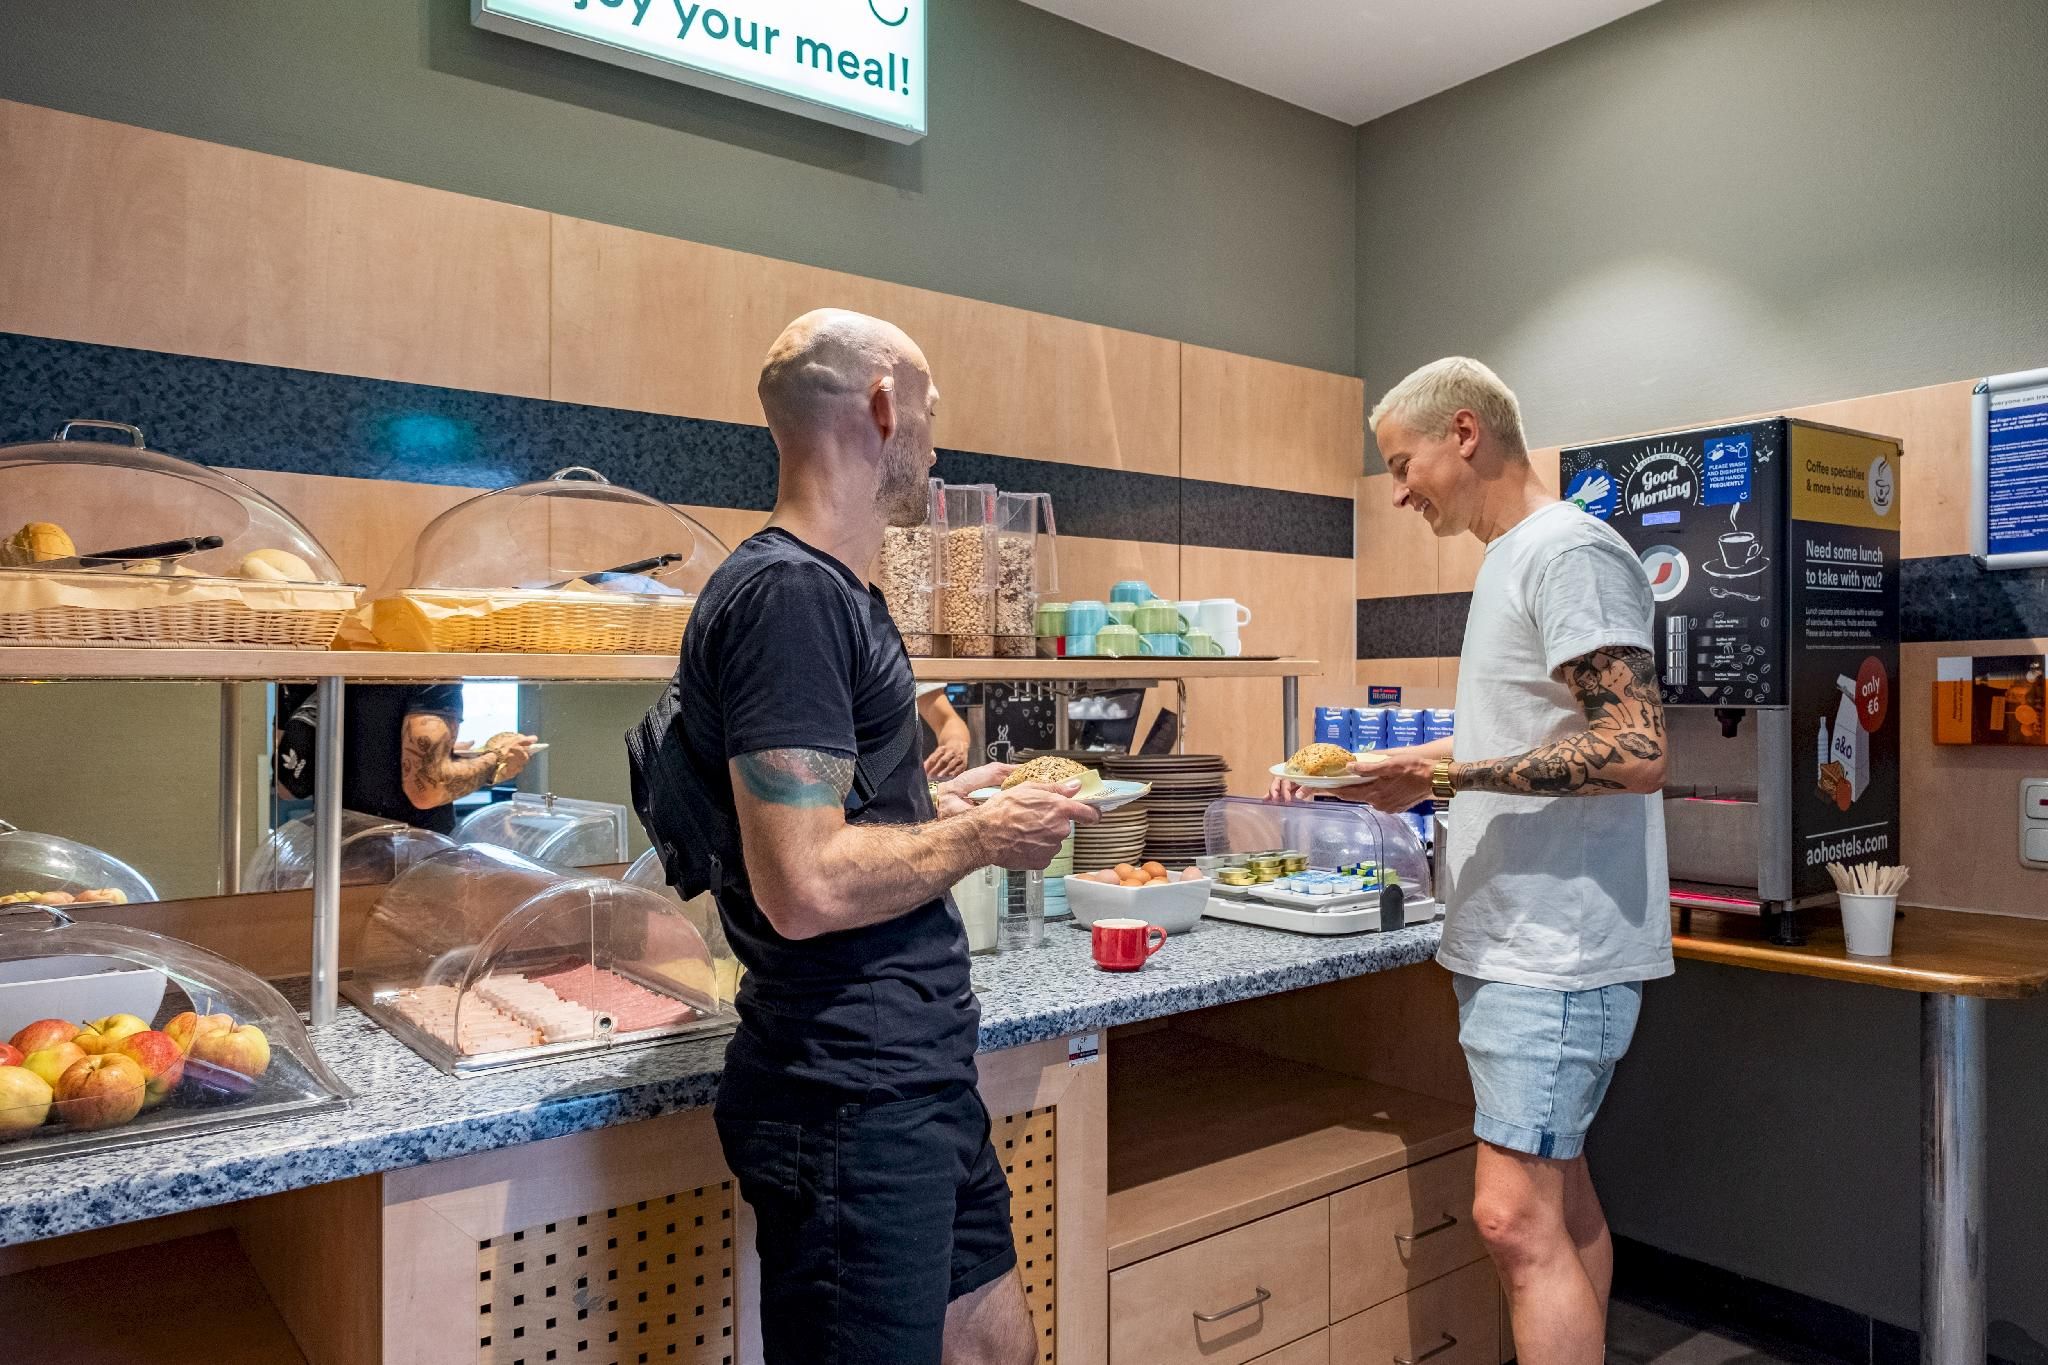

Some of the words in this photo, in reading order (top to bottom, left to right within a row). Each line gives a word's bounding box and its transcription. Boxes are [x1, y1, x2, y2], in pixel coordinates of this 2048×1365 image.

[674, 0, 780, 55] your
[796, 34, 909, 96] meal!
[1641, 465, 1678, 491] Good
[1806, 459, 1829, 475] Coffee
[1830, 463, 1865, 481] specialties
[1709, 480, 1744, 488] FREQUENTLY
[1806, 479, 1812, 491] &
[1813, 483, 1831, 494] more
[1832, 483, 1843, 496] hot
[1844, 484, 1865, 499] drinks
[1631, 481, 1691, 511] Morning
[1806, 539, 1832, 559] Need
[1833, 547, 1857, 561] some
[1859, 544, 1883, 562] lunch
[1806, 569, 1816, 585] to
[1818, 569, 1838, 586] take
[1840, 569, 1860, 587] with
[1861, 571, 1883, 591] you?
[1861, 675, 1880, 698] only
[1867, 697, 1879, 715] €6
[1835, 737, 1852, 760] a&o
[1806, 834, 1888, 866] aohostels.com
